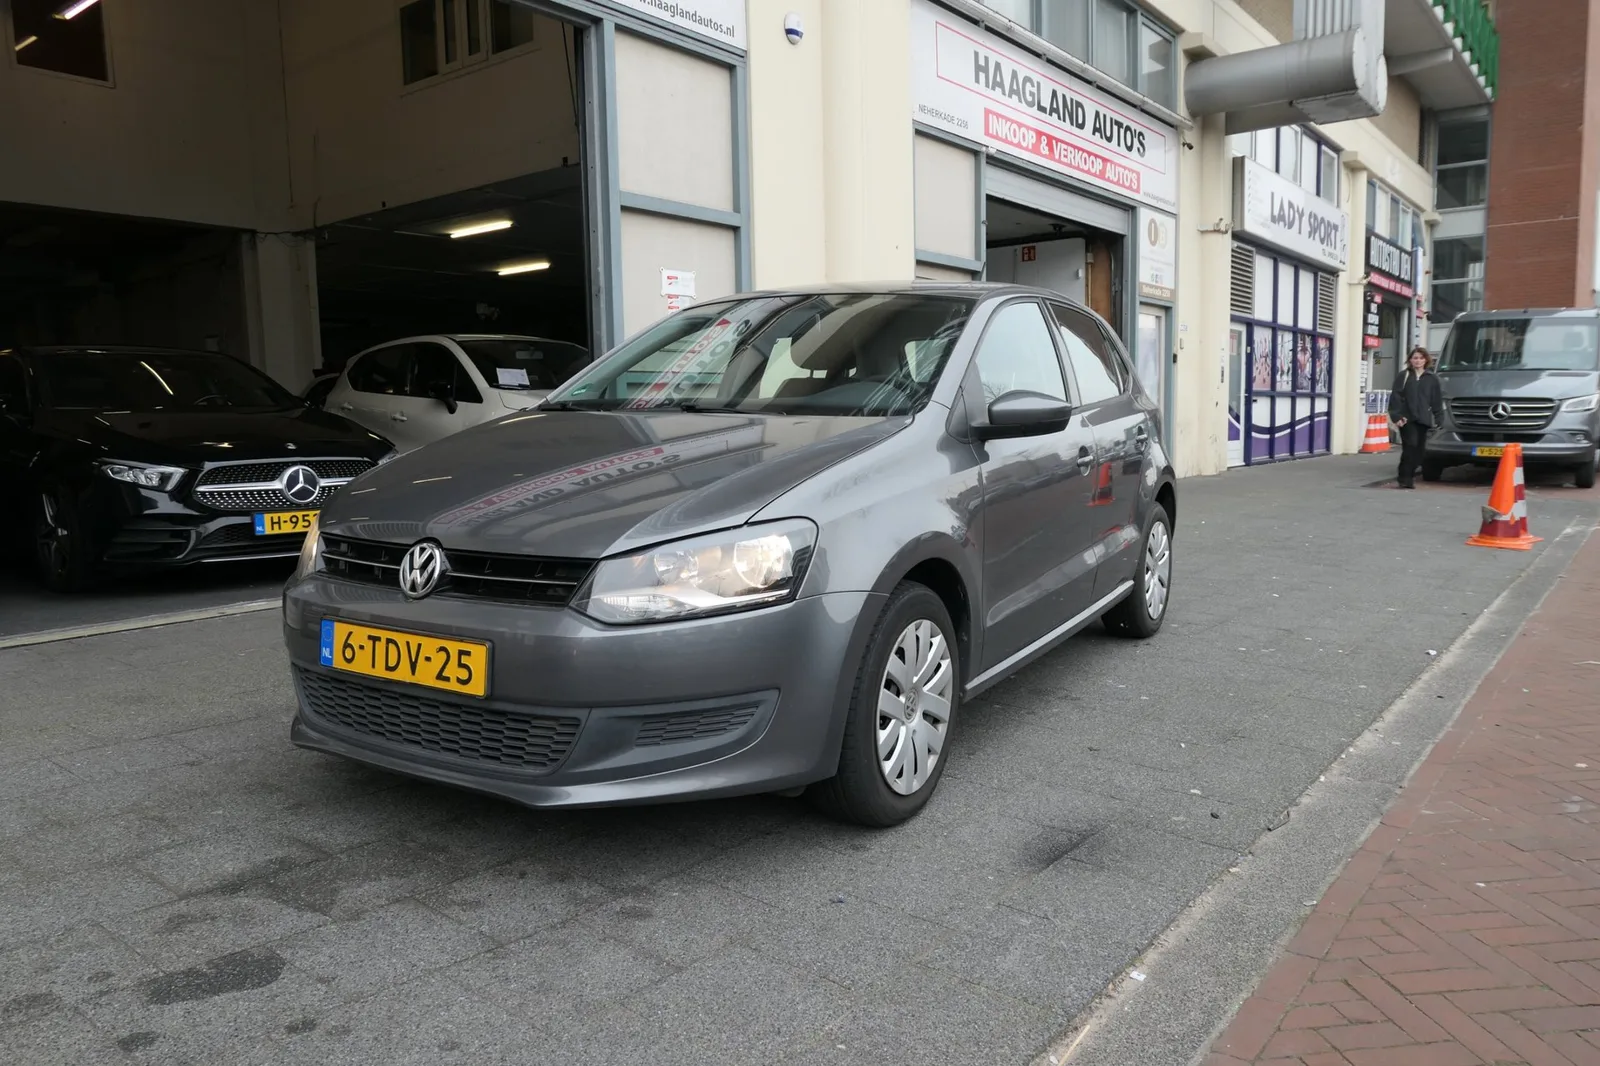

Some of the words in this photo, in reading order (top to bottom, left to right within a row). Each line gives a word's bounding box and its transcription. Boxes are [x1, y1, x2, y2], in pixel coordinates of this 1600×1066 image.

[918, 103, 955, 125] NEHERKADE
[973, 50, 1087, 131] HAAGLAND
[1091, 112, 1146, 158] AUTO'S
[988, 118, 1037, 151] INKOOP
[1040, 135, 1049, 155] &
[1052, 140, 1103, 174] VERKOOP
[1105, 161, 1138, 190] AUTO'S
[1270, 191, 1305, 235] LADY
[1308, 211, 1339, 250] SPORT
[270, 513, 318, 531] H-95
[322, 647, 332, 659] NL
[342, 631, 473, 686] 6-TDV-25
